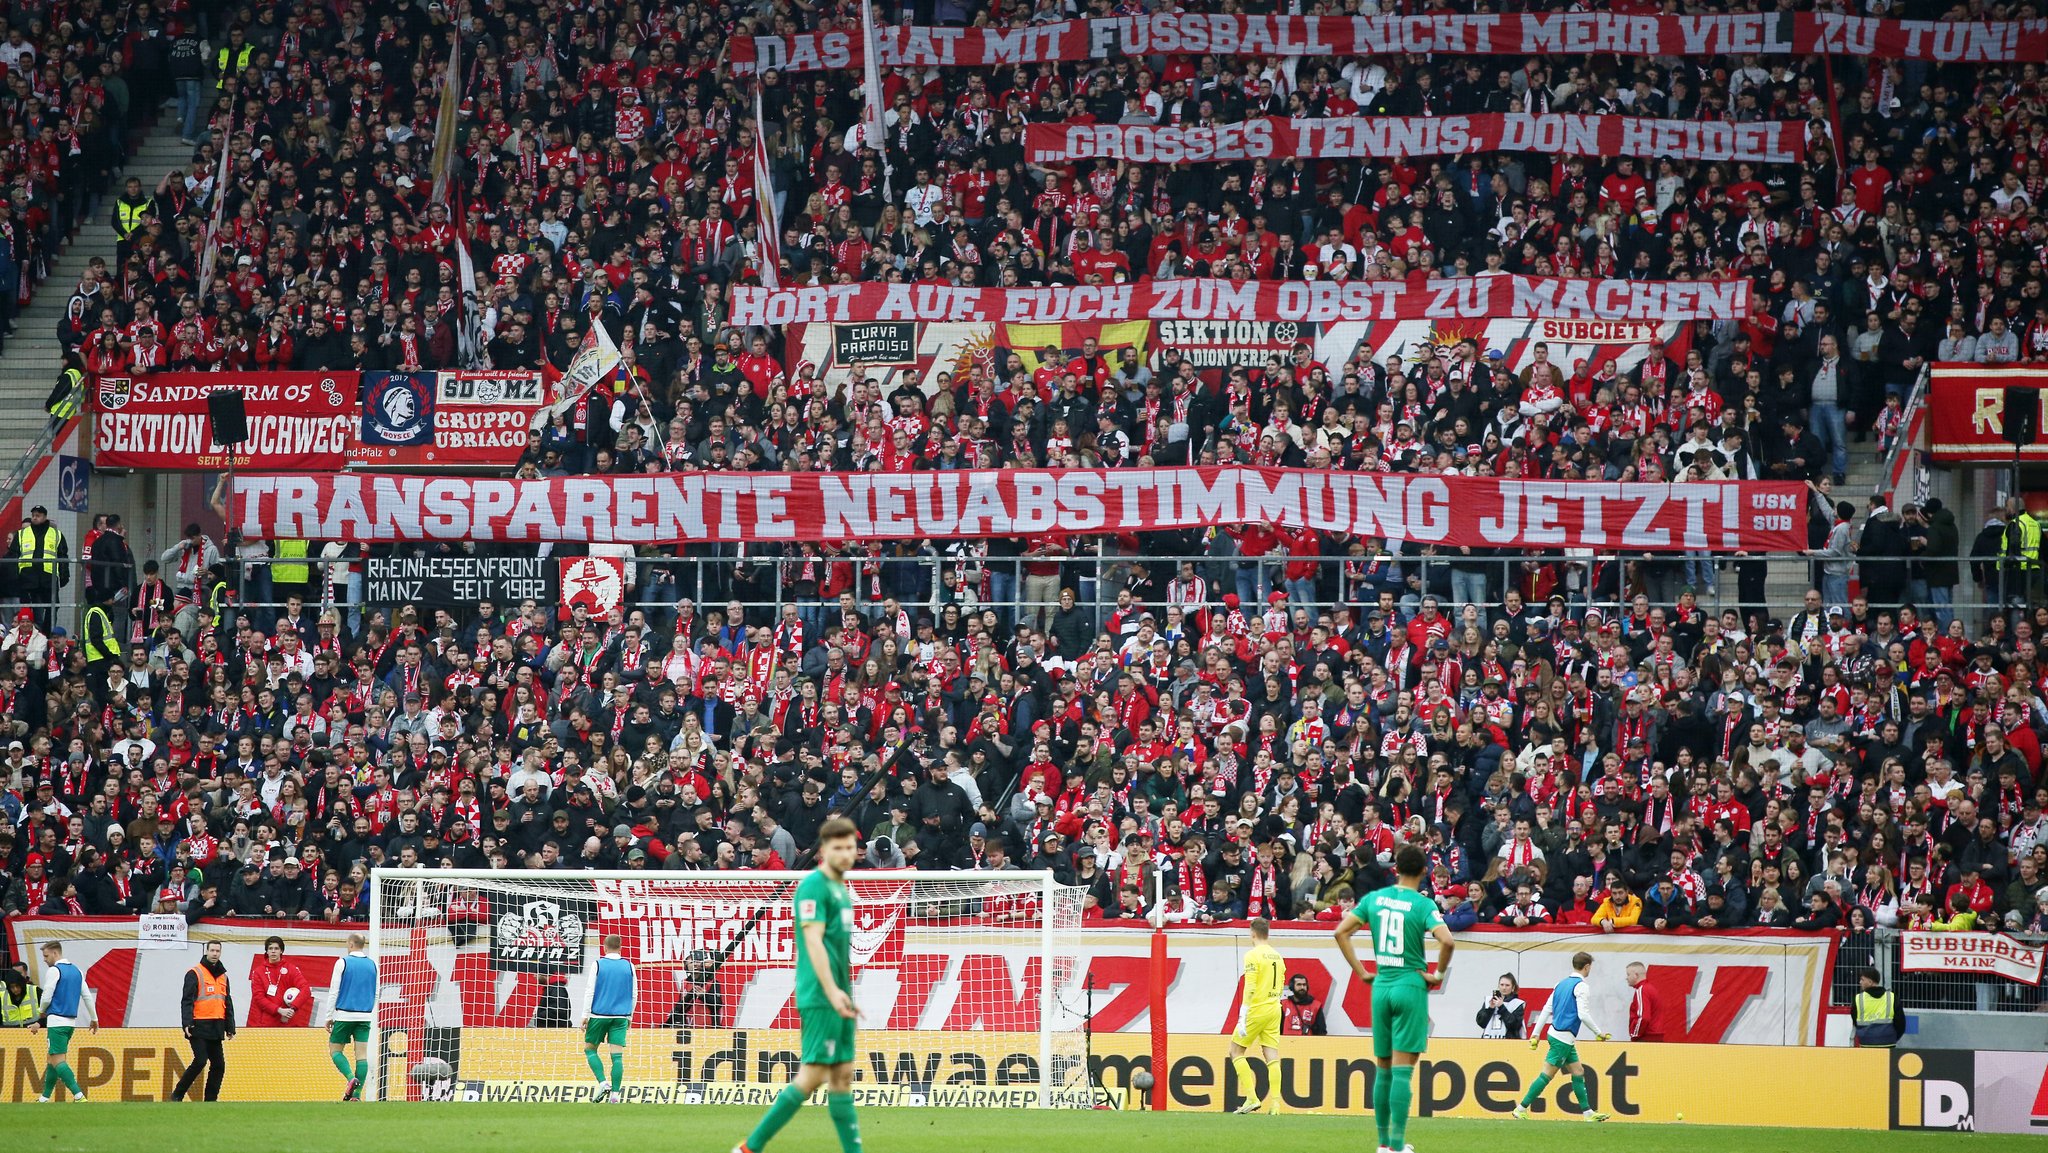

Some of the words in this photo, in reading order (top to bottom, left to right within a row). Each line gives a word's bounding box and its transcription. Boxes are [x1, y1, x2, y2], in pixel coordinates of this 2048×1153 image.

[874, 26, 964, 66] HAT
[982, 21, 1070, 64] MIT
[1090, 14, 1332, 58] FUSSBALL
[1351, 14, 1499, 53] NICHT
[1520, 13, 1659, 53] MEHR
[1678, 12, 1792, 54] VIEL
[1813, 12, 1880, 55] ZU
[1290, 114, 1482, 159] TENNIS,
[1498, 113, 1600, 156] DON
[1621, 116, 1795, 163] HEIDEL
[732, 284, 861, 326] HÖRT
[875, 282, 985, 322] AUF,
[1001, 284, 1133, 323] EUCH
[1148, 278, 1260, 320] ZUM
[1277, 280, 1407, 321] OBST
[1424, 277, 1493, 319] ZU
[1511, 275, 1749, 321] MACHEN!
[851, 326, 897, 340] CURVA
[1159, 320, 1270, 345] SEKTION
[1543, 320, 1663, 341] SUBCIETY
[841, 340, 909, 354] PARADISO
[460, 371, 483, 379] friends
[507, 371, 530, 379] friends
[285, 384, 312, 403] 05
[445, 379, 474, 398] SD
[505, 379, 539, 399] MZ
[433, 411, 526, 429] GRUPPO
[100, 413, 204, 452] SEKTION
[383, 431, 402, 439] BOYS
[197, 456, 221, 466] SEIT
[344, 448, 383, 457] nd-Pfalz
[234, 474, 796, 540] TRANSPARENTE
[819, 469, 1450, 541] NEUABSTIMMUNG
[1479, 480, 1740, 548] JETZT!
[1752, 494, 1797, 510] USM
[1753, 515, 1792, 531] SUB
[368, 581, 424, 601] MAINZ
[453, 580, 492, 600] SEIT
[500, 579, 546, 600] 1982
[1377, 908, 1405, 955] 19
[501, 945, 582, 960] MAINZ
[1910, 937, 2036, 965] SUBURBIA
[1944, 956, 1995, 968] MAINZ
[0, 1047, 206, 1102] MPEN
